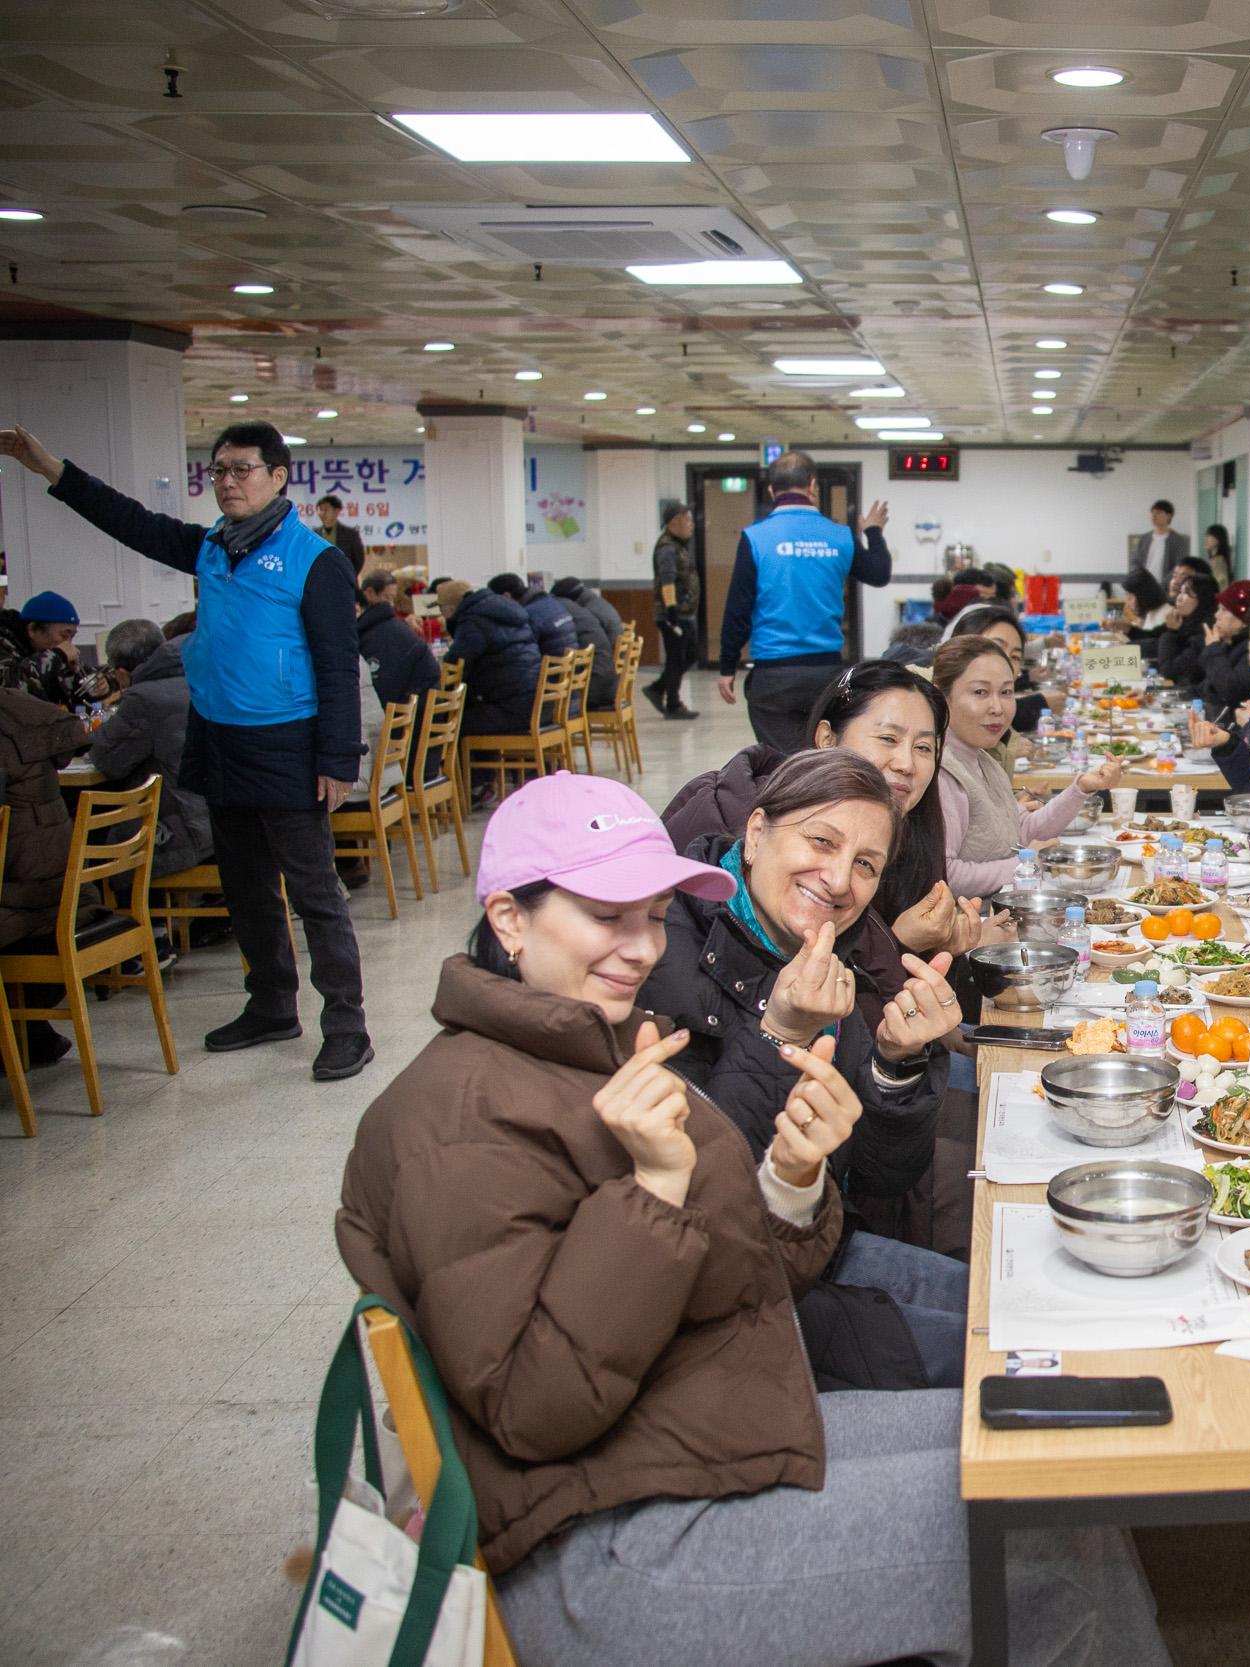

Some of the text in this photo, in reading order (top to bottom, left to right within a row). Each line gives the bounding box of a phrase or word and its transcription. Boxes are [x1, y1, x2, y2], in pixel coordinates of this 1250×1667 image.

[290, 458, 390, 494] 따뜻한
[366, 502, 390, 517] 6일
[1085, 656, 1138, 670] 중앙교회
[1133, 1030, 1159, 1038] 아이시스
